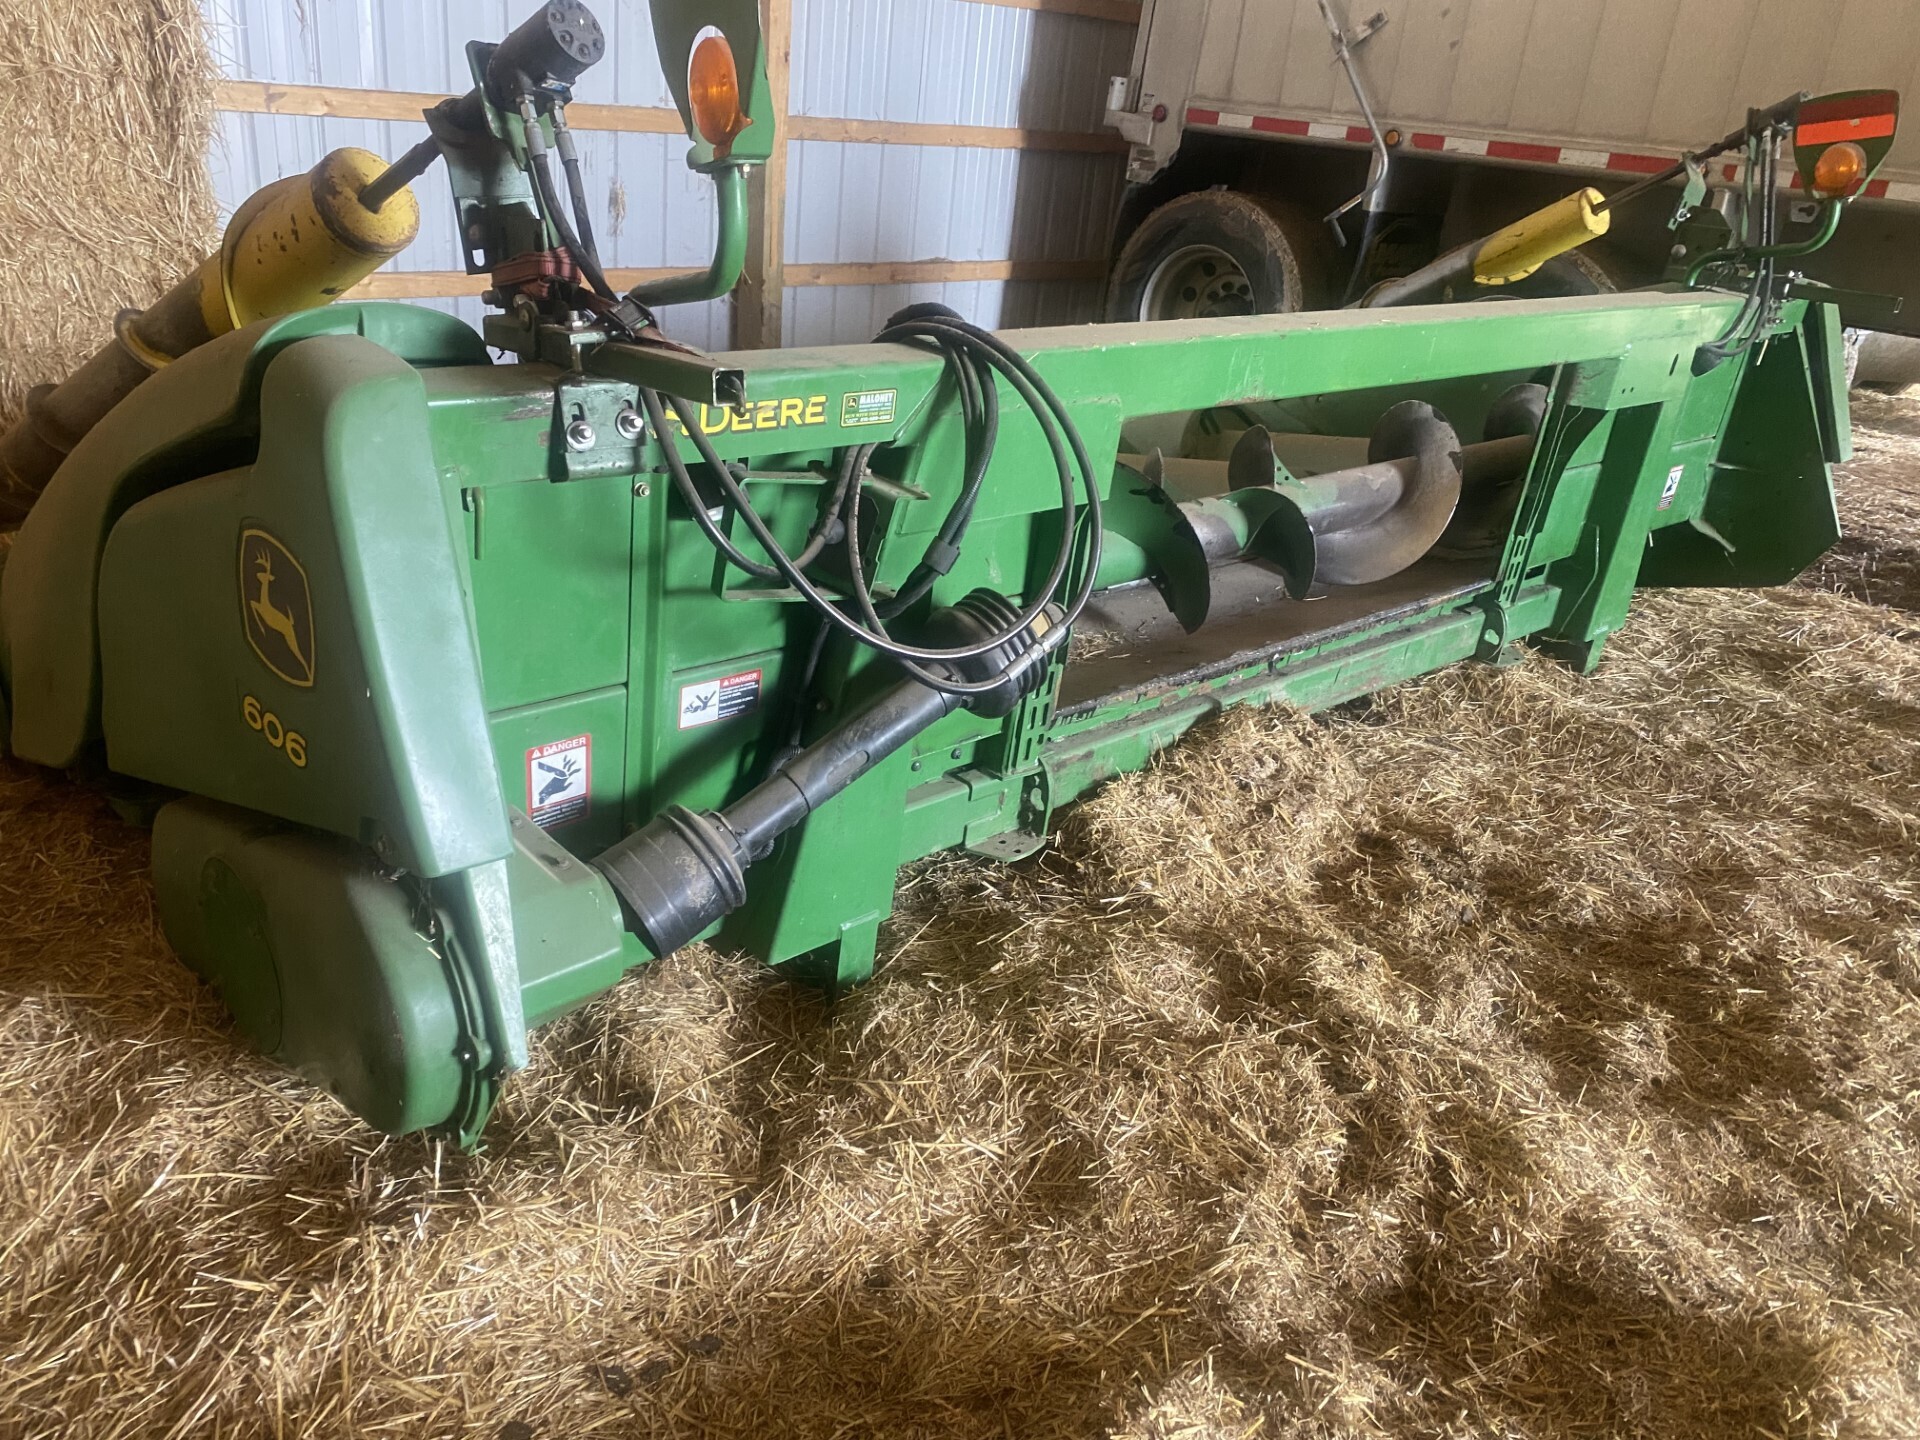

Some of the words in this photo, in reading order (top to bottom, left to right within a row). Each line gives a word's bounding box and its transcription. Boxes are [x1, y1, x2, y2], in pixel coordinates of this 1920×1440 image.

[859, 393, 893, 404] MALONEY
[700, 395, 827, 435] DEERE
[730, 673, 758, 685] DANGER
[243, 695, 307, 768] 606
[543, 737, 587, 756] DANGER
